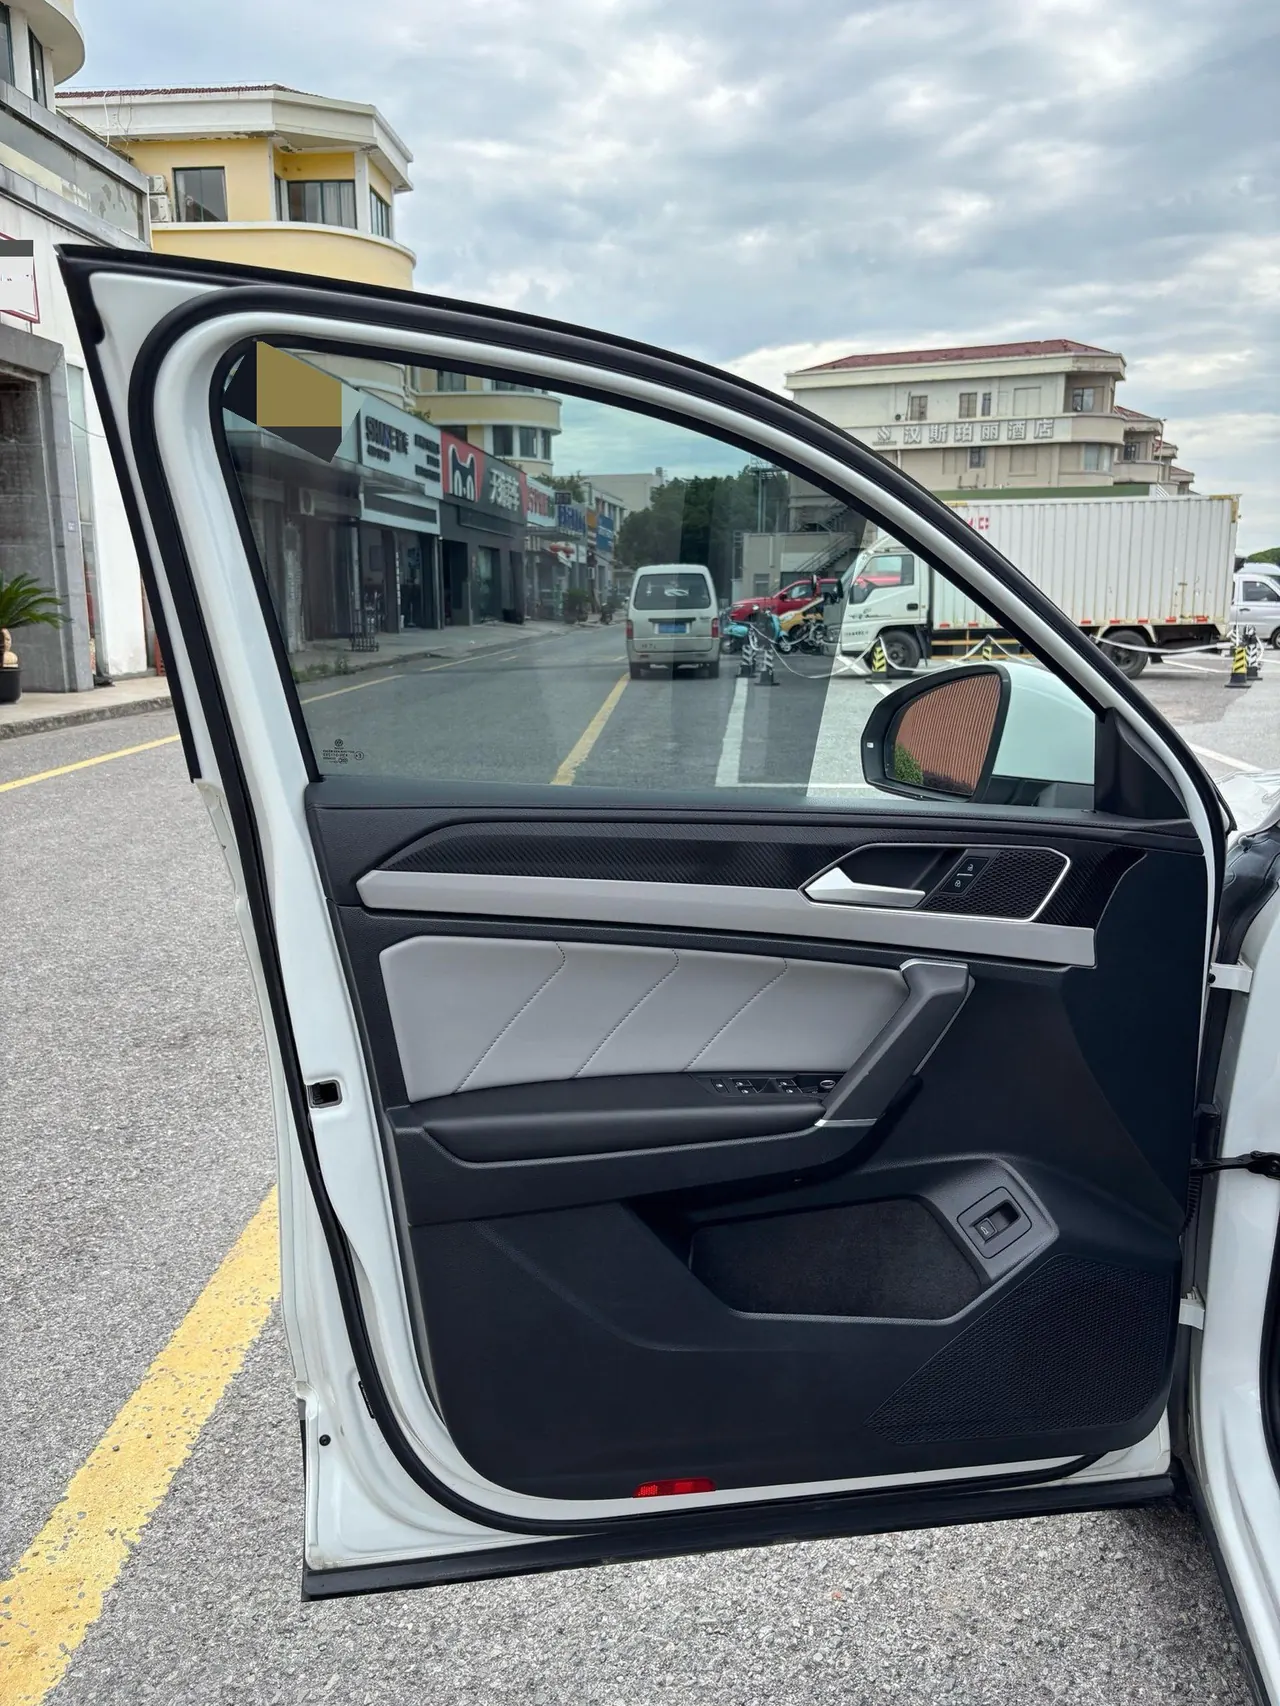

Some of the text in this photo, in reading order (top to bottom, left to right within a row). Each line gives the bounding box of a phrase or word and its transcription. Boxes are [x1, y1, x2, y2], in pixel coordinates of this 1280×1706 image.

[903, 419, 1055, 445] 汉斯珀丽酒店
